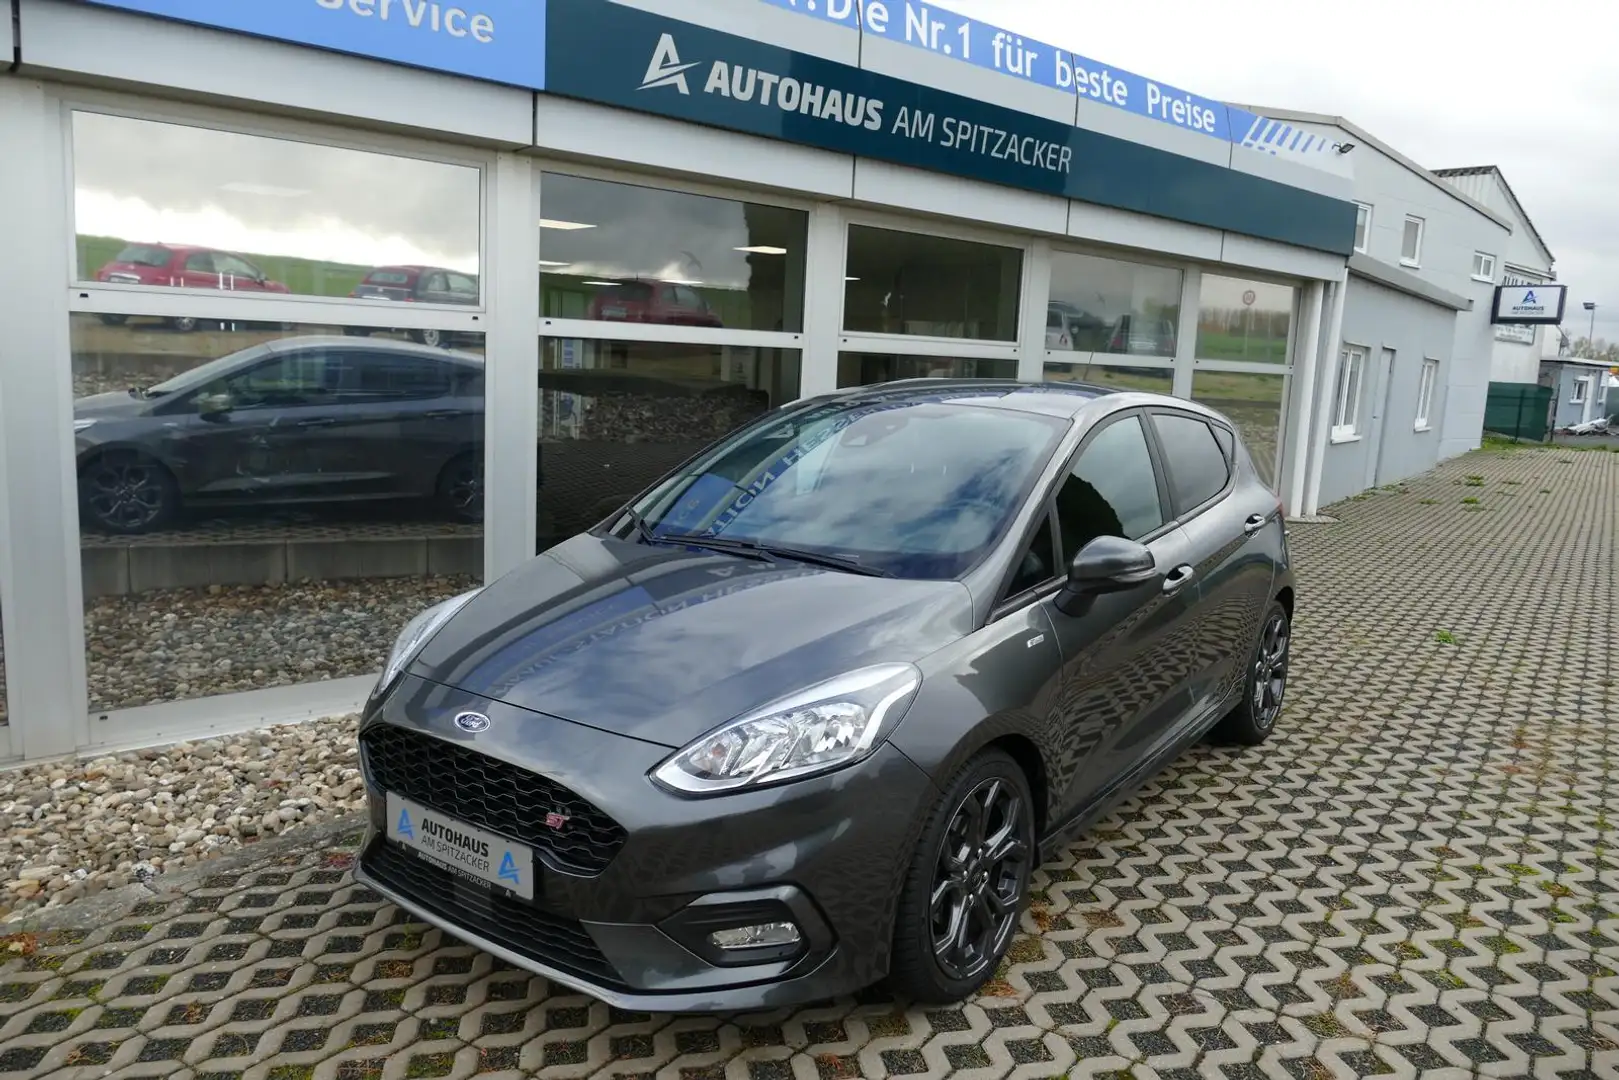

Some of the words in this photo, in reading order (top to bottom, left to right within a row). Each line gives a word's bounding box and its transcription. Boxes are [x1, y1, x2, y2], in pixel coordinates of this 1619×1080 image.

[315, 0, 495, 43] ervice
[992, 32, 1039, 78] für
[1055, 50, 1128, 106] beste
[1147, 82, 1216, 133] Preise
[704, 60, 884, 131] AUTOHAUS
[891, 106, 935, 143] AM
[940, 116, 1073, 174] SPITZACKER
[421, 818, 489, 858] AUTOHAUS
[421, 835, 435, 850] AM
[436, 841, 490, 873] SPITZACKER
